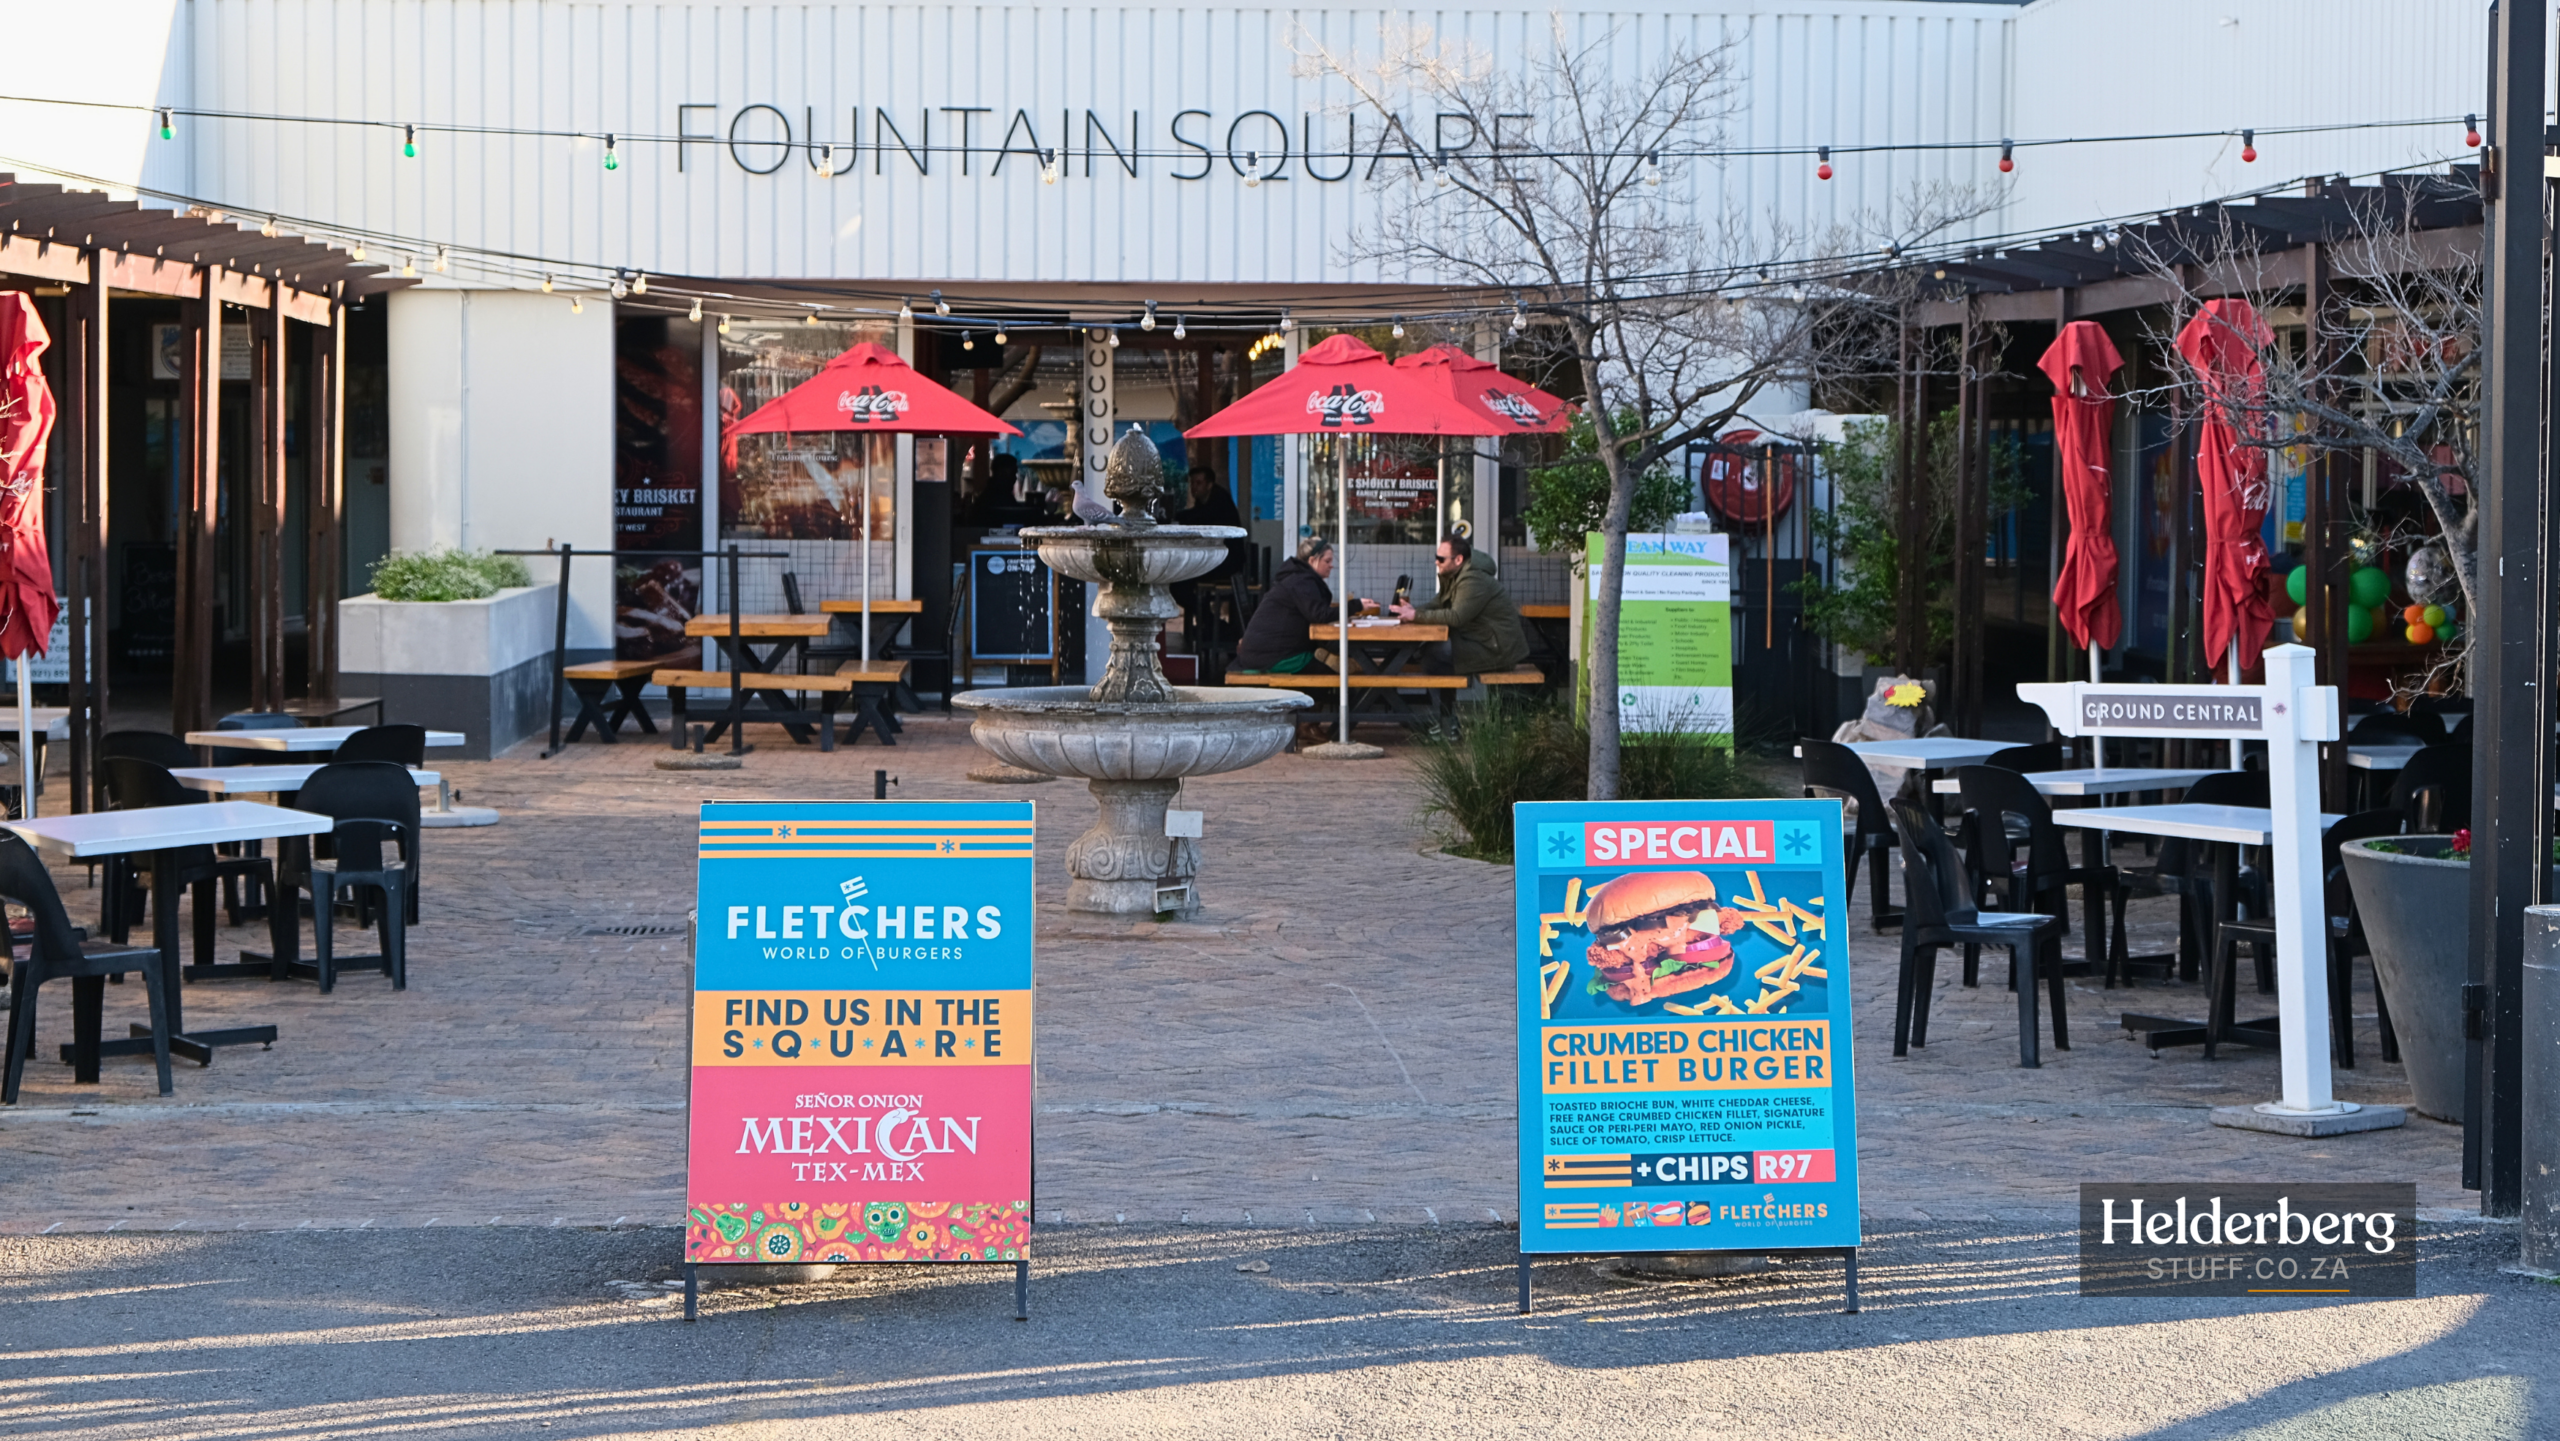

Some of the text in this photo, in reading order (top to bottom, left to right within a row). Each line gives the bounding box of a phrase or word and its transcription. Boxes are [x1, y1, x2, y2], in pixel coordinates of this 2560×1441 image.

[677, 104, 1535, 184] FOUNTAIN SQUARE
[837, 390, 909, 412] Coca-Cola
[1306, 390, 1384, 414] Coca-Cola
[1355, 477, 1397, 489] SMOKEY
[633, 488, 696, 504] BRISKET
[1670, 541, 1708, 554] WAY
[2085, 702, 2259, 722] GROUND CENTRAL
[1593, 827, 1767, 861] SPECIAL
[727, 905, 1002, 940] FLETCHERS
[763, 947, 964, 960] WORLD OF BURGERS
[726, 998, 1000, 1027] FIND US IN THE
[1548, 1027, 1824, 1057] CRUMBED CHICKEN
[1549, 1056, 1824, 1085] FILLET BURGER
[795, 1092, 923, 1109] SEÑOR ONION
[1549, 1097, 1815, 1111] TOASTED BRIOCHE BUN, WHITE CHEDDAR CHEESE,
[1550, 1108, 1825, 1123] FREE RANGE CRUMBED CHICKEN FILLET, SIGNATURE
[735, 1108, 981, 1162] MEXICAN
[1550, 1120, 1805, 1134] SAUCE OR PERI-PERI MAYO, RED ONION PICKLE,
[1550, 1133, 1735, 1146] SLICE OF TOMATO, CRISP LETTUCE.
[791, 1162, 925, 1183] TEX-MEX
[1759, 1154, 1812, 1180] R97
[1720, 1203, 1828, 1220] FLETCHERS
